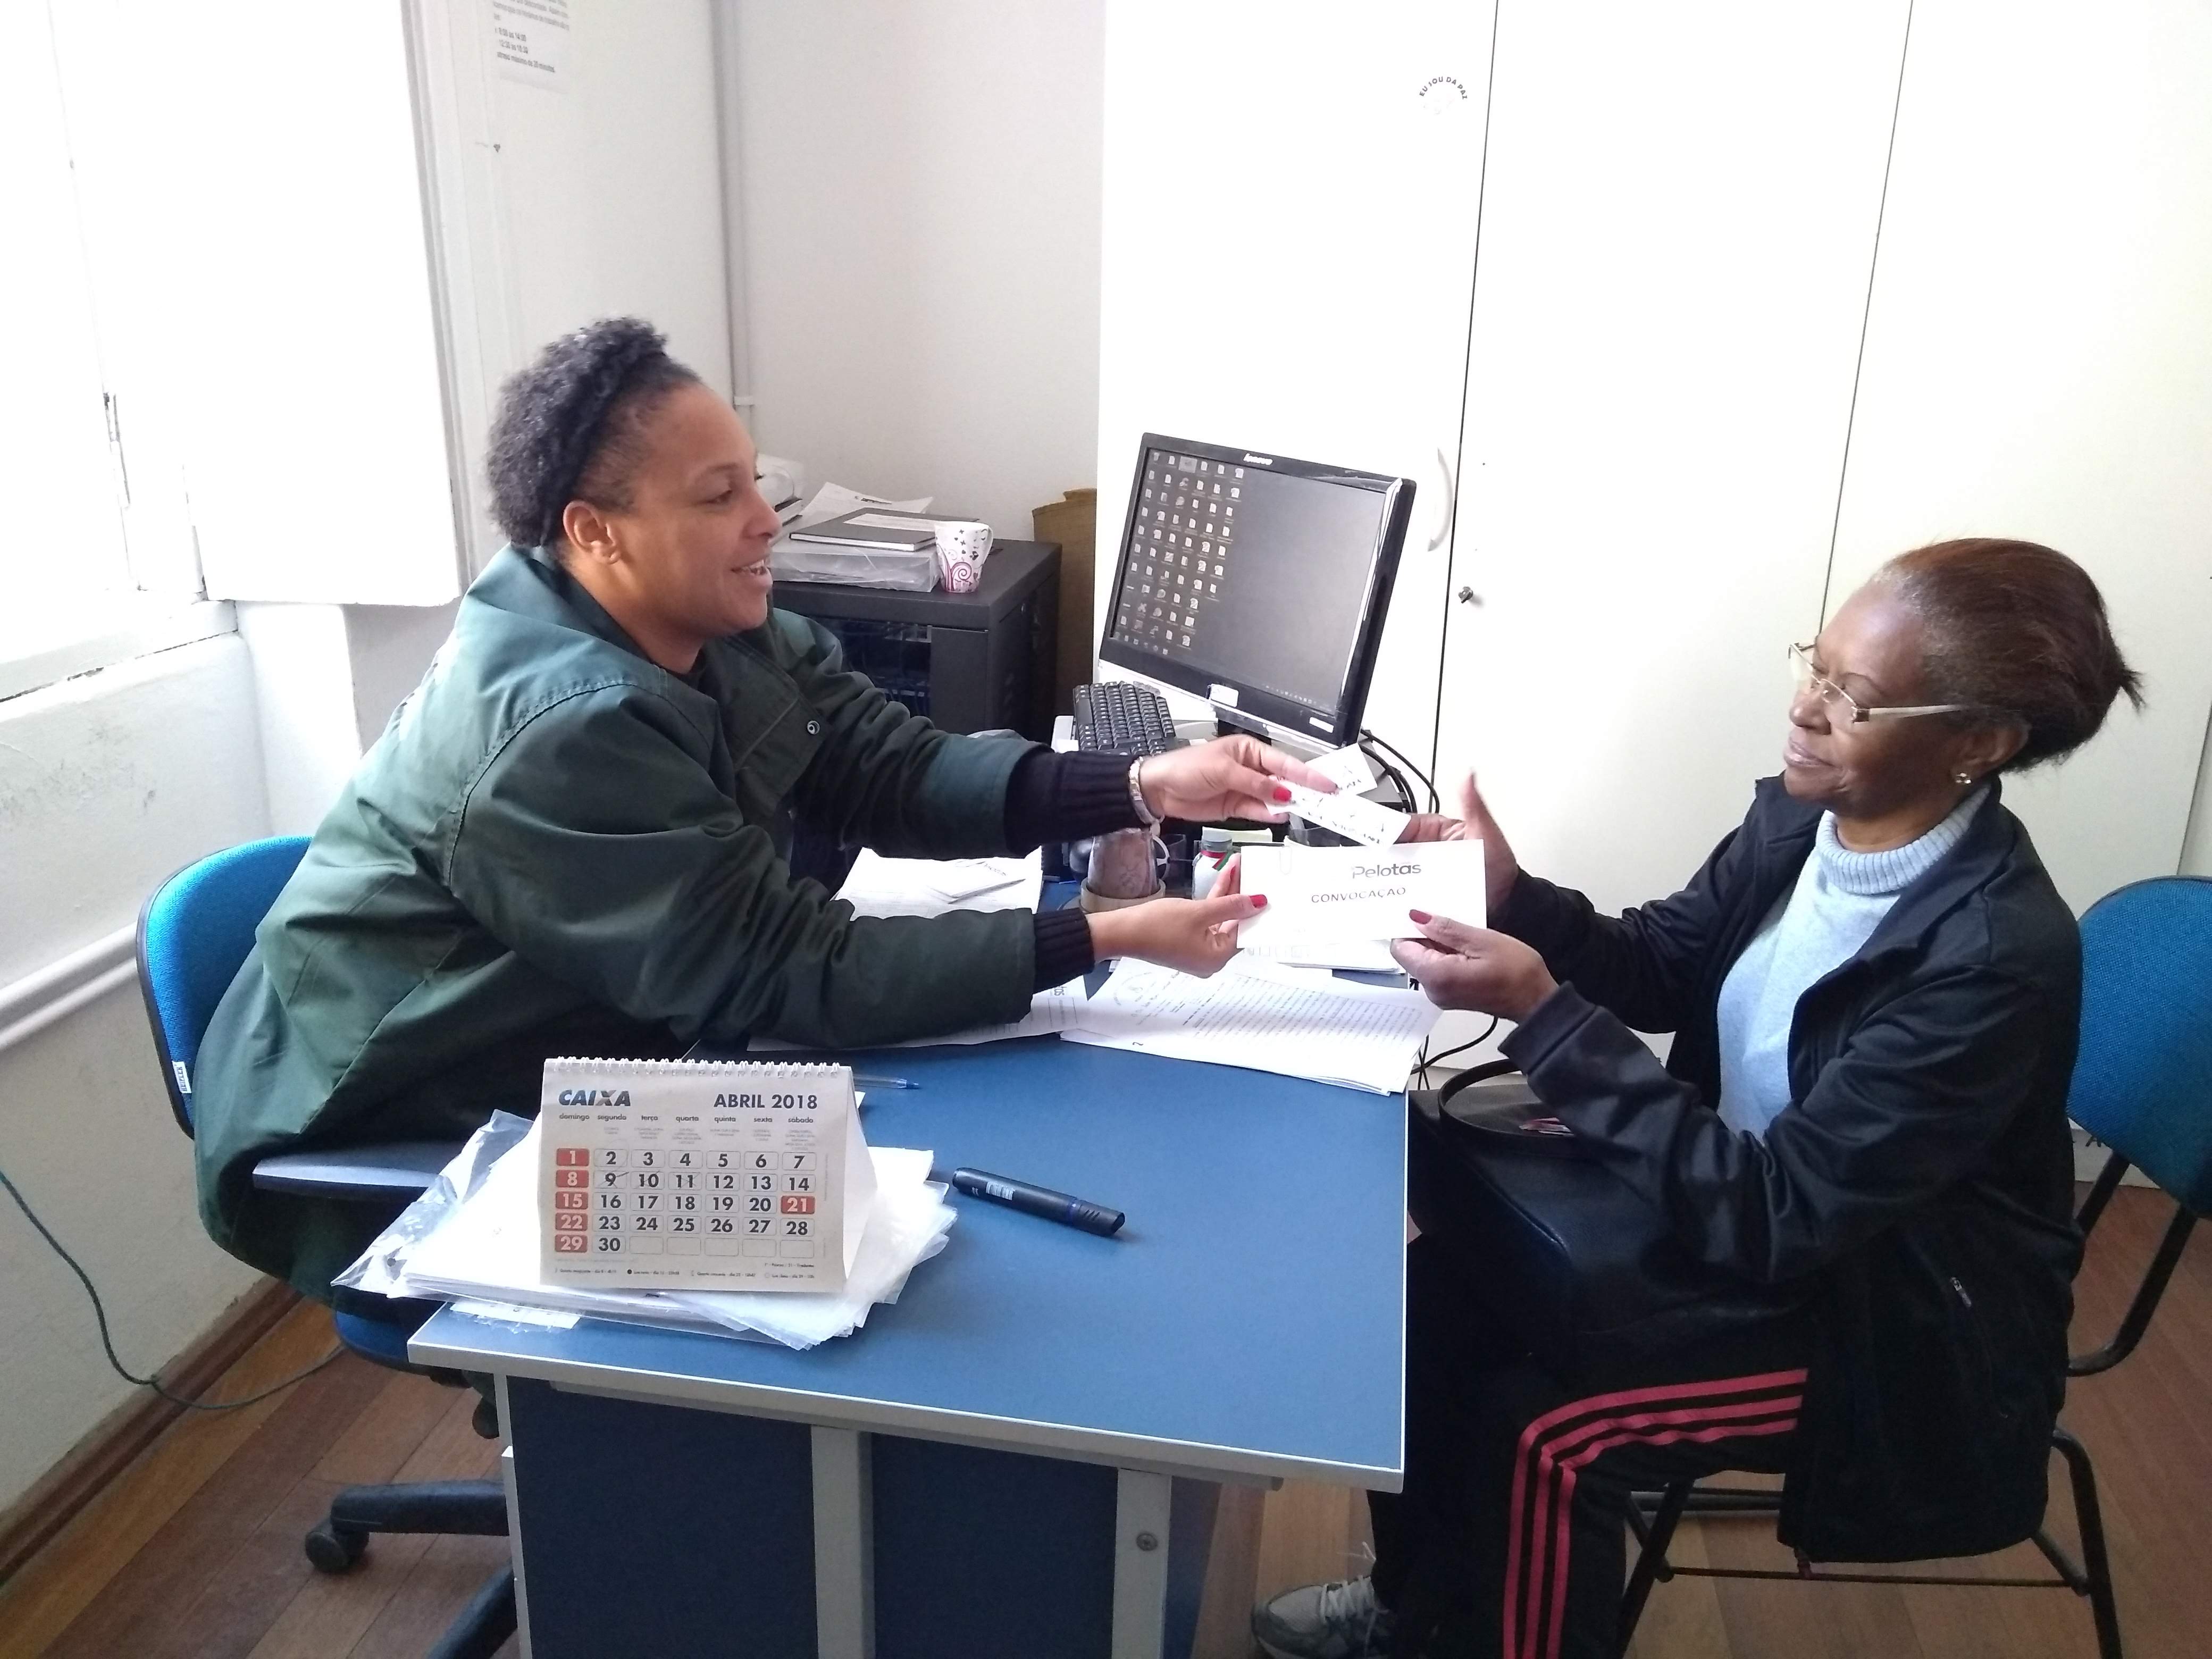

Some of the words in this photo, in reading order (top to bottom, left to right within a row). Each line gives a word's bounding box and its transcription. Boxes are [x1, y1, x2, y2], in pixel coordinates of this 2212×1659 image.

[1419, 86, 1428, 96] EU
[1446, 77, 1456, 85] DA
[1352, 864, 1421, 879] Pelotas
[558, 1090, 631, 1107] CAIXA
[714, 1094, 765, 1108] ABRIL
[772, 1094, 817, 1109] 2018
[559, 1113, 590, 1121] domingo
[569, 1150, 576, 1164] 1
[606, 1151, 616, 1165] 2
[643, 1152, 653, 1166] 3
[680, 1153, 691, 1167] 4
[718, 1153, 728, 1168] 5
[755, 1154, 767, 1168] 6
[793, 1155, 805, 1169] 7
[567, 1171, 577, 1186] 8
[605, 1172, 616, 1186] 9
[639, 1174, 659, 1188] 10
[676, 1175, 693, 1188] 11
[714, 1175, 734, 1189] 12
[751, 1175, 772, 1190] 13
[789, 1177, 809, 1191] 14
[563, 1193, 583, 1208] 15
[601, 1194, 621, 1209] 16
[638, 1195, 658, 1209] 17
[675, 1196, 695, 1210] 18
[713, 1196, 733, 1211] 19
[749, 1197, 772, 1212] 20
[787, 1197, 807, 1212] 21
[561, 1214, 583, 1229] 22
[599, 1216, 621, 1230] 23
[636, 1217, 658, 1230] 24
[673, 1218, 694, 1232] 25
[710, 1218, 733, 1233] 26
[749, 1219, 771, 1233] 27
[786, 1221, 808, 1237] 28
[560, 1235, 583, 1251] 29
[598, 1237, 621, 1252] 30
